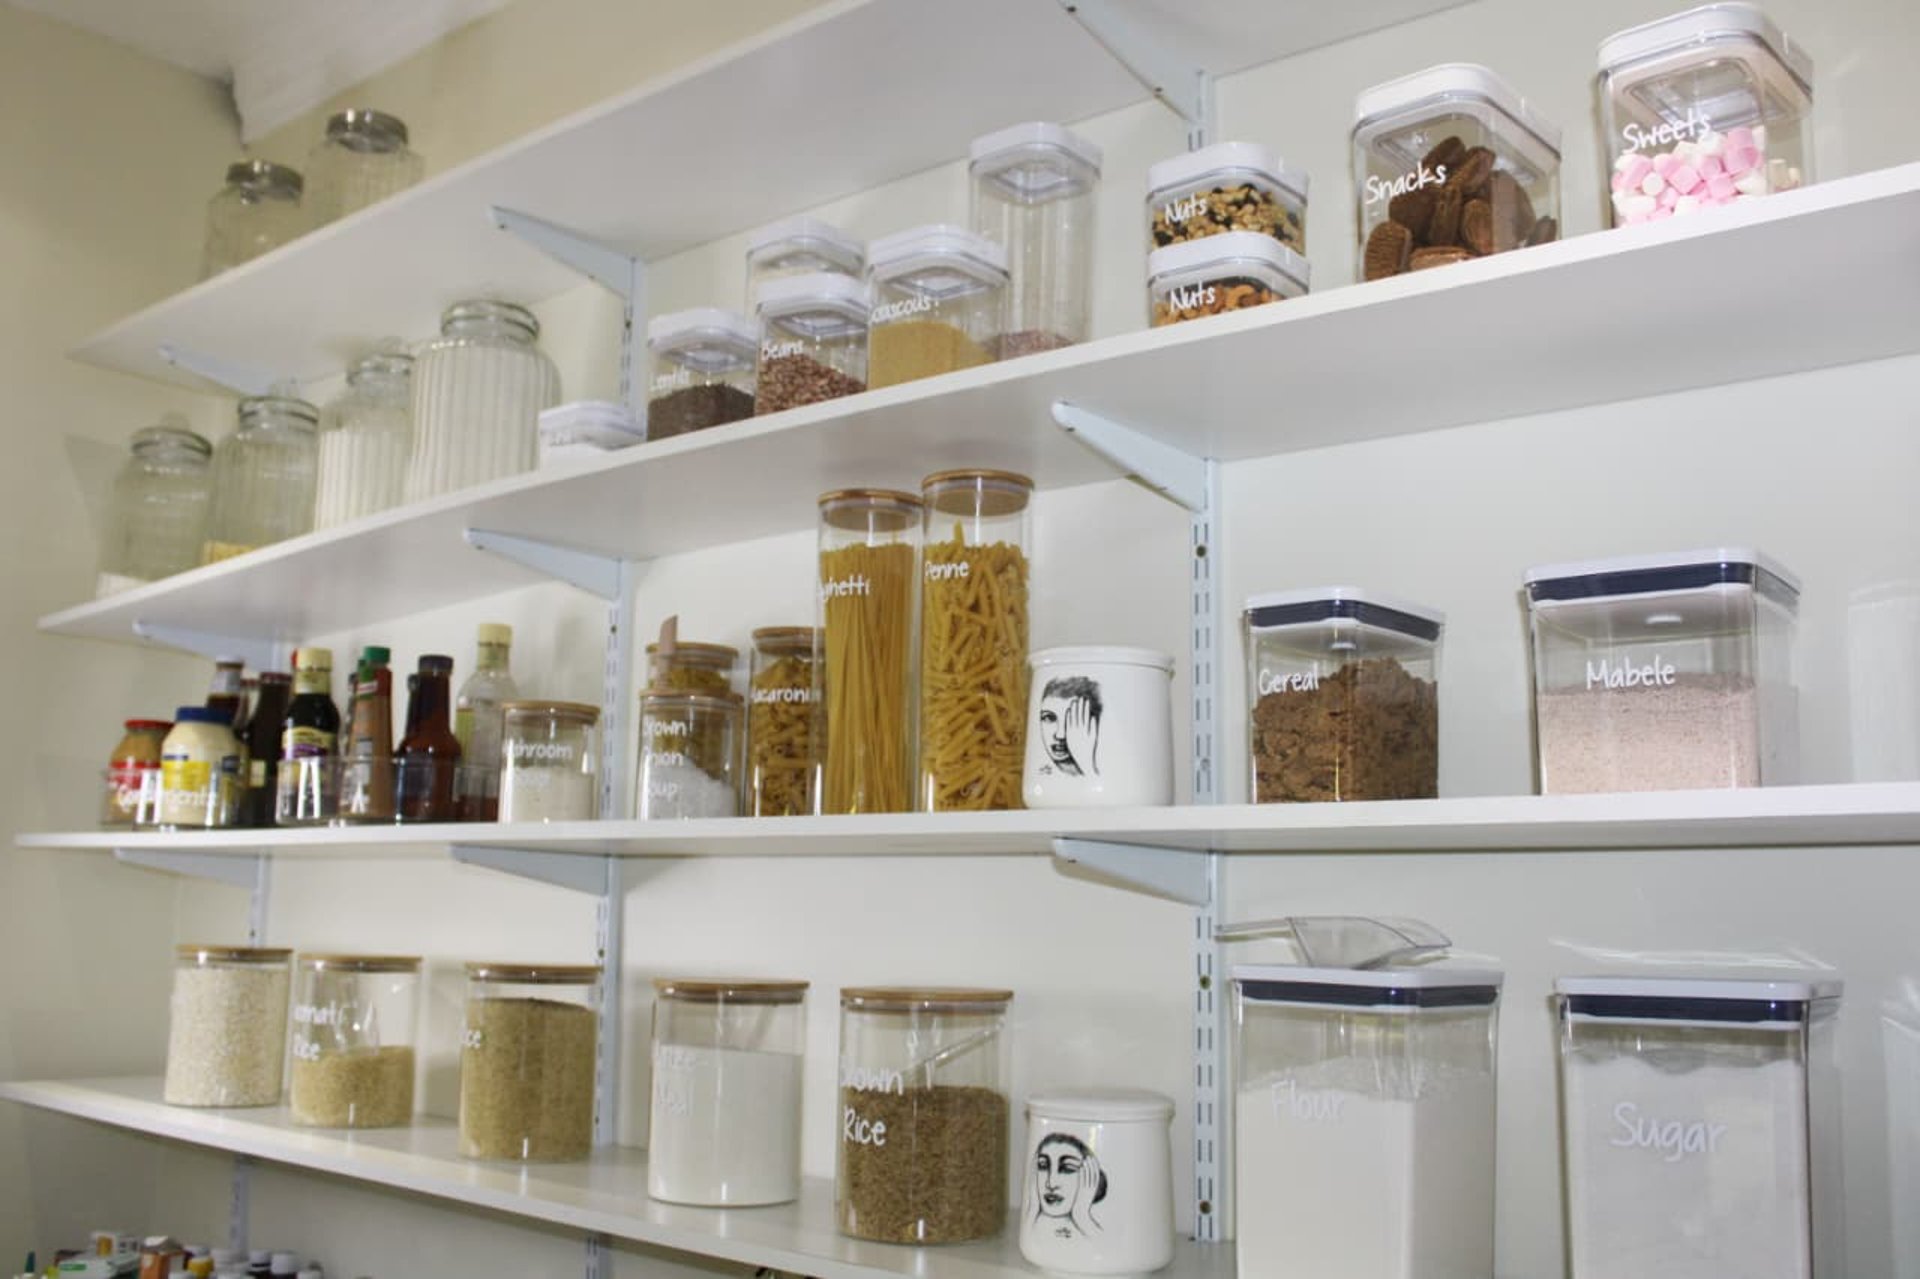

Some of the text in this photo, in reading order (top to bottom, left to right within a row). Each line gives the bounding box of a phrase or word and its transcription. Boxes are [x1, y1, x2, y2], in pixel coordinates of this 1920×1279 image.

[1622, 112, 1711, 158] Sweets
[1364, 160, 1448, 206] Snacks
[1164, 194, 1208, 225] Nuts
[870, 293, 932, 325] ouscous
[1170, 280, 1216, 313] Nuts
[925, 559, 970, 583] Penne
[1258, 659, 1320, 696] Cereal
[1585, 653, 1677, 691] Mabele
[1271, 1079, 1344, 1122] Flour
[843, 1104, 887, 1147] Rice
[1610, 1101, 1728, 1163] Sugar
